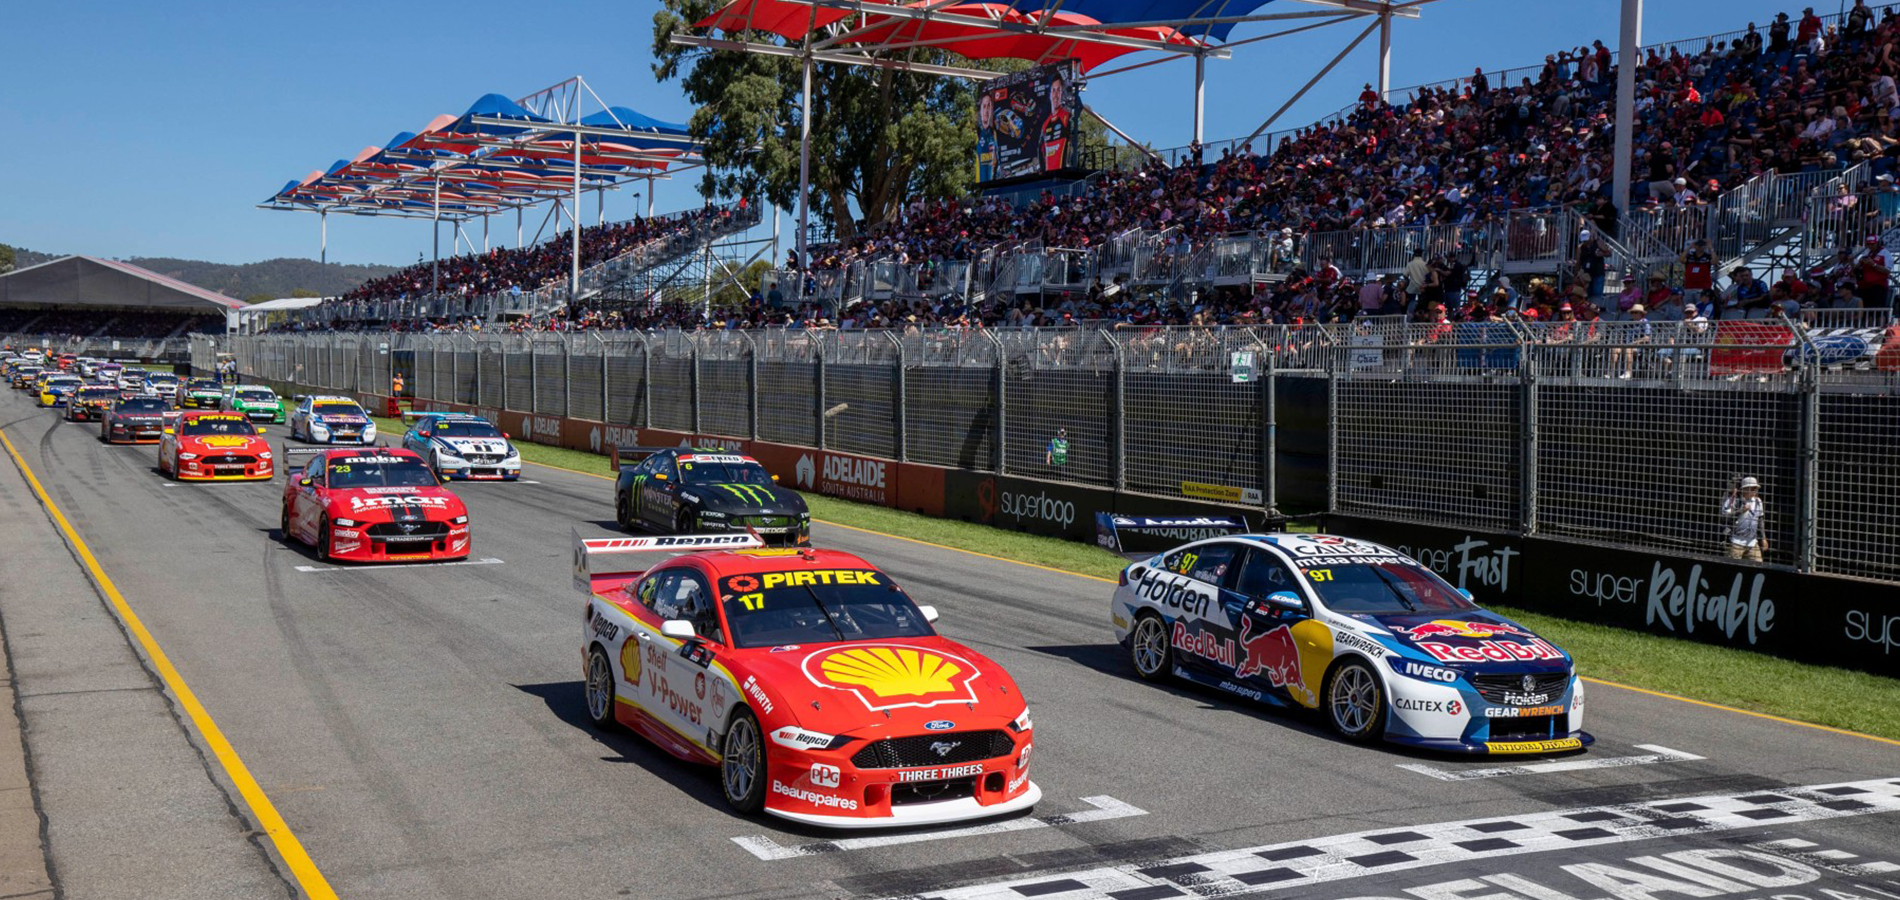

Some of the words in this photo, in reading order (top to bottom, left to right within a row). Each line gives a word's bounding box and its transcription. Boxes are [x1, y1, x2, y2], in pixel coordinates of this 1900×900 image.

[534, 416, 559, 435] ADELAIDE
[604, 428, 639, 448] ADELAIDE
[335, 465, 351, 473] 23
[822, 455, 886, 488] ADELAIDE
[822, 481, 845, 496] SOUTH
[846, 485, 886, 502] AUSTRALIA
[1184, 485, 1196, 494] RAA
[1197, 487, 1222, 498] Protection
[1222, 489, 1239, 498] Zone
[1247, 492, 1259, 500] RAA
[354, 504, 399, 514] INSURANCE
[1002, 490, 1074, 529] superloop
[654, 535, 749, 546] Repco
[1295, 545, 1398, 556] CALTEX
[1180, 553, 1198, 571] 97
[1295, 556, 1351, 567] mtaa
[1353, 556, 1401, 566] super
[1454, 535, 1520, 593] Fast
[763, 570, 881, 589] PIRTEK
[1309, 569, 1334, 582] 97
[738, 593, 764, 610] 17
[1136, 570, 1210, 617] Holden
[1570, 568, 1644, 606] super
[1646, 560, 1776, 645] Reliable
[592, 611, 619, 641] Repco
[1335, 631, 1385, 658] GEARWRENCH
[647, 644, 667, 672] Shell
[1405, 662, 1457, 682] IVECO
[647, 668, 702, 725] V-Power
[1219, 681, 1236, 691] mtaa
[1236, 685, 1255, 696] super
[749, 683, 774, 714] WÜRTH
[1395, 698, 1443, 713] CALTEX
[1504, 692, 1549, 705] Holden
[1485, 705, 1564, 717] GEARWRENCH
[929, 721, 950, 730] Ford
[796, 733, 829, 746] Repco
[1491, 742, 1540, 752] NATIONAL
[1541, 738, 1582, 750] STORAGE
[811, 766, 840, 786] PPG
[898, 768, 938, 782] THREE
[941, 764, 983, 779] THREES
[773, 780, 857, 810] Beaurepaires
